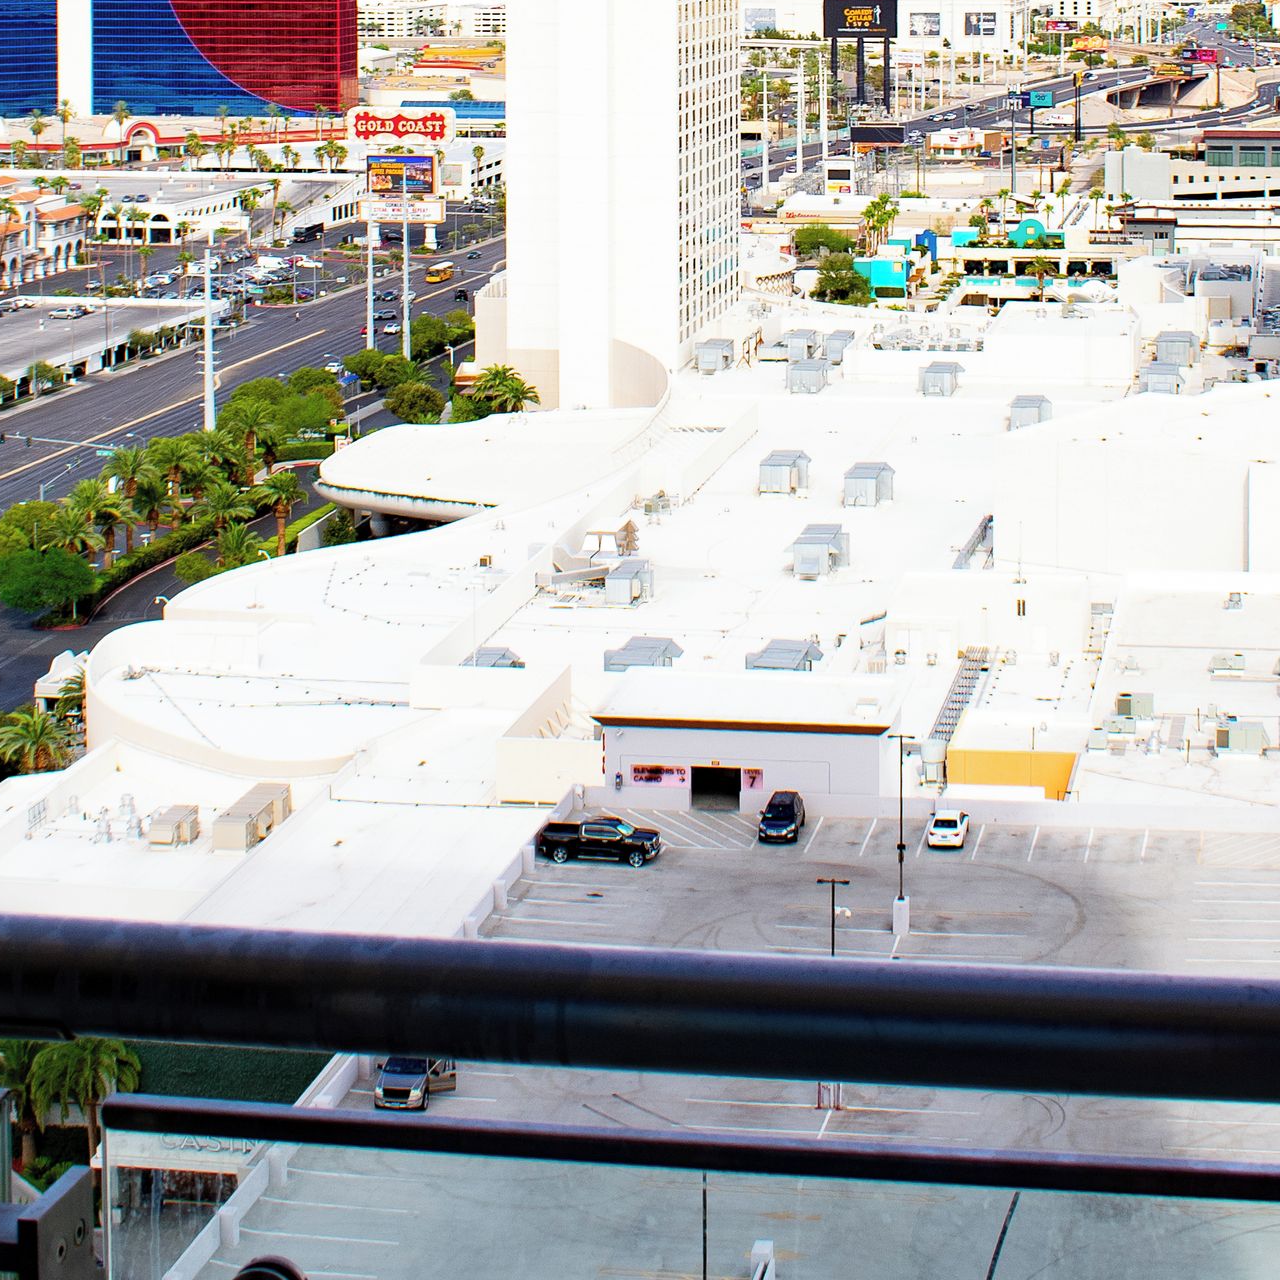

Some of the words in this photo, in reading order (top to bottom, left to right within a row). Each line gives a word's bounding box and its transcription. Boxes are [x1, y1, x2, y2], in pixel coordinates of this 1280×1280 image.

[357, 120, 394, 132] GOLD
[398, 120, 443, 133] COAST
[749, 776, 757, 788] 7
[160, 1133, 260, 1154] CASIN
